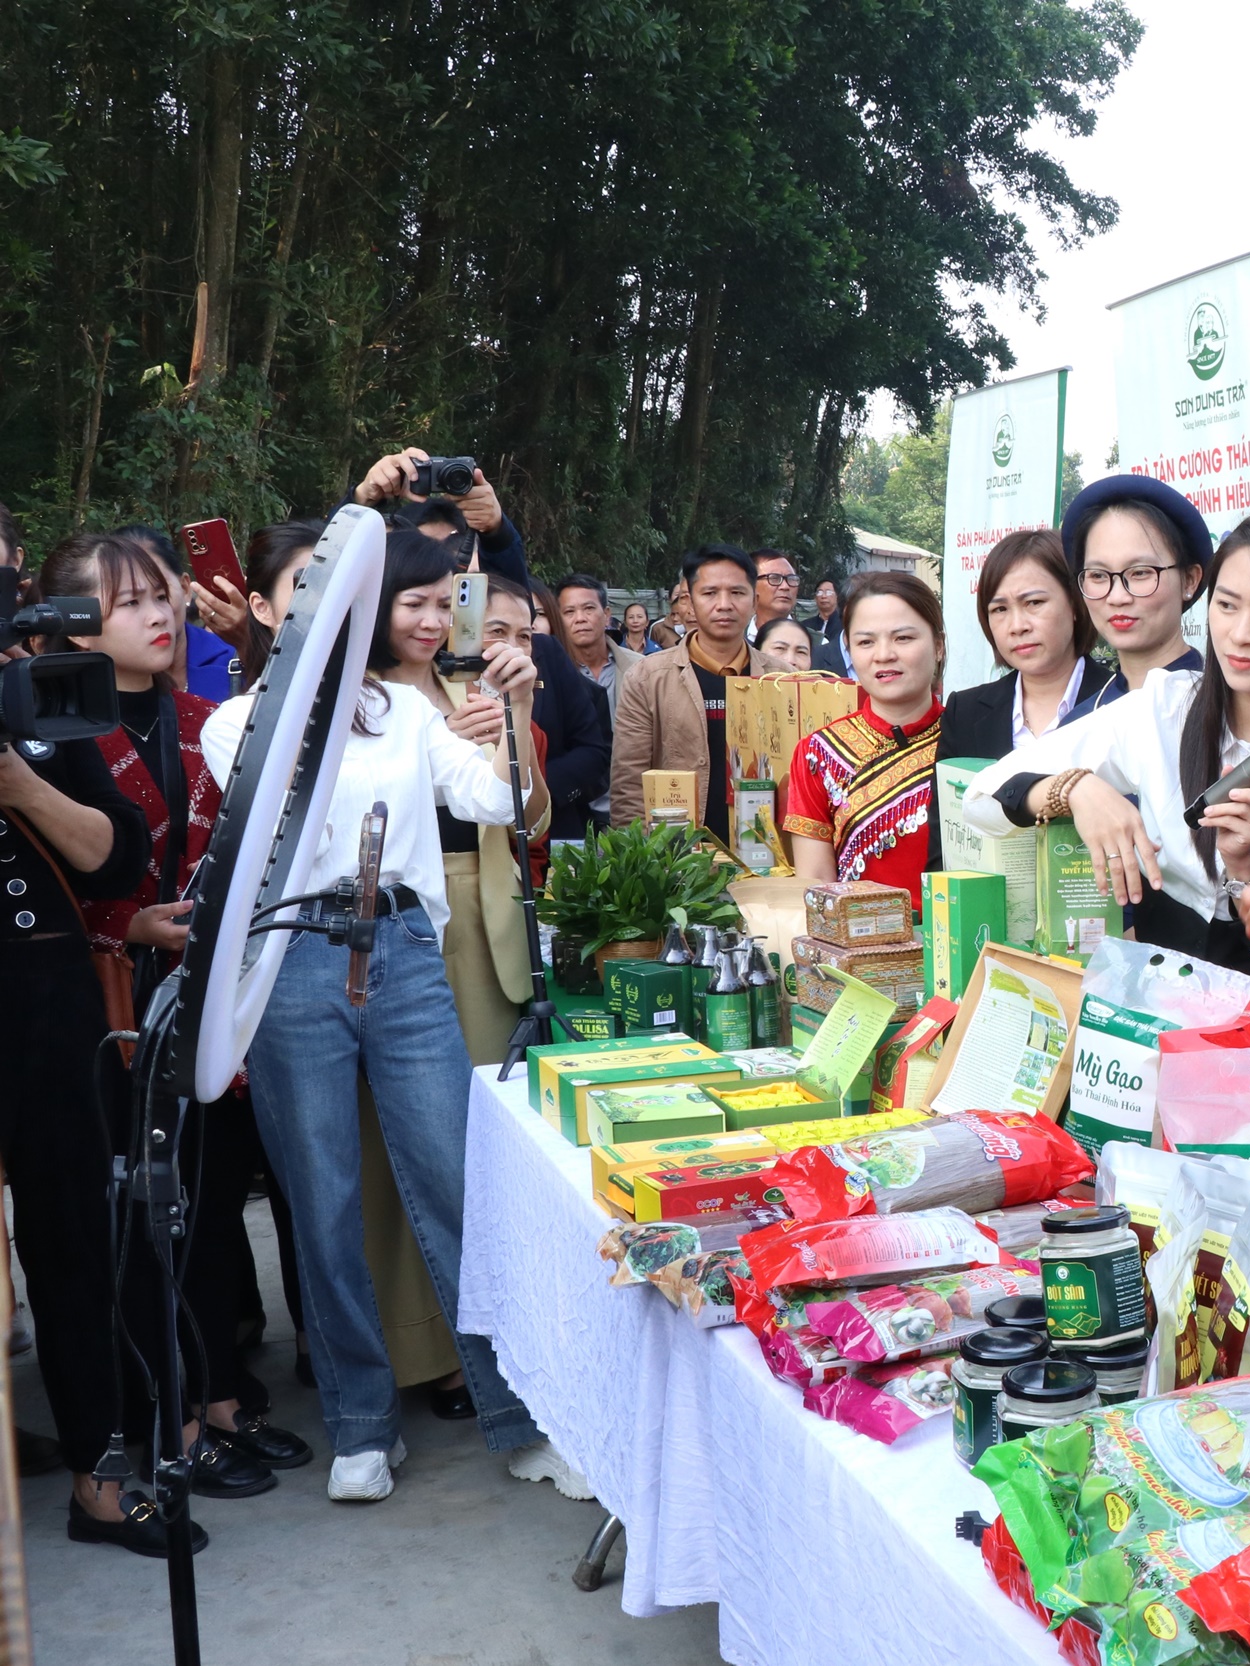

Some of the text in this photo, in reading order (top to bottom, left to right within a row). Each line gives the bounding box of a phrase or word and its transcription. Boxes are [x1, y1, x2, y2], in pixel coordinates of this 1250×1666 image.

[1196, 390, 1224, 412] DUNG
[1227, 379, 1246, 404] TRÀ
[1154, 453, 1175, 483] TÂN
[1226, 476, 1250, 516] HIỆU
[1076, 1049, 1143, 1093] Mỳ Gạo
[1085, 1088, 1101, 1102] Thai
[1102, 1094, 1118, 1109] Định
[1121, 1098, 1141, 1112] Hóa
[1047, 1284, 1062, 1302] BỘT
